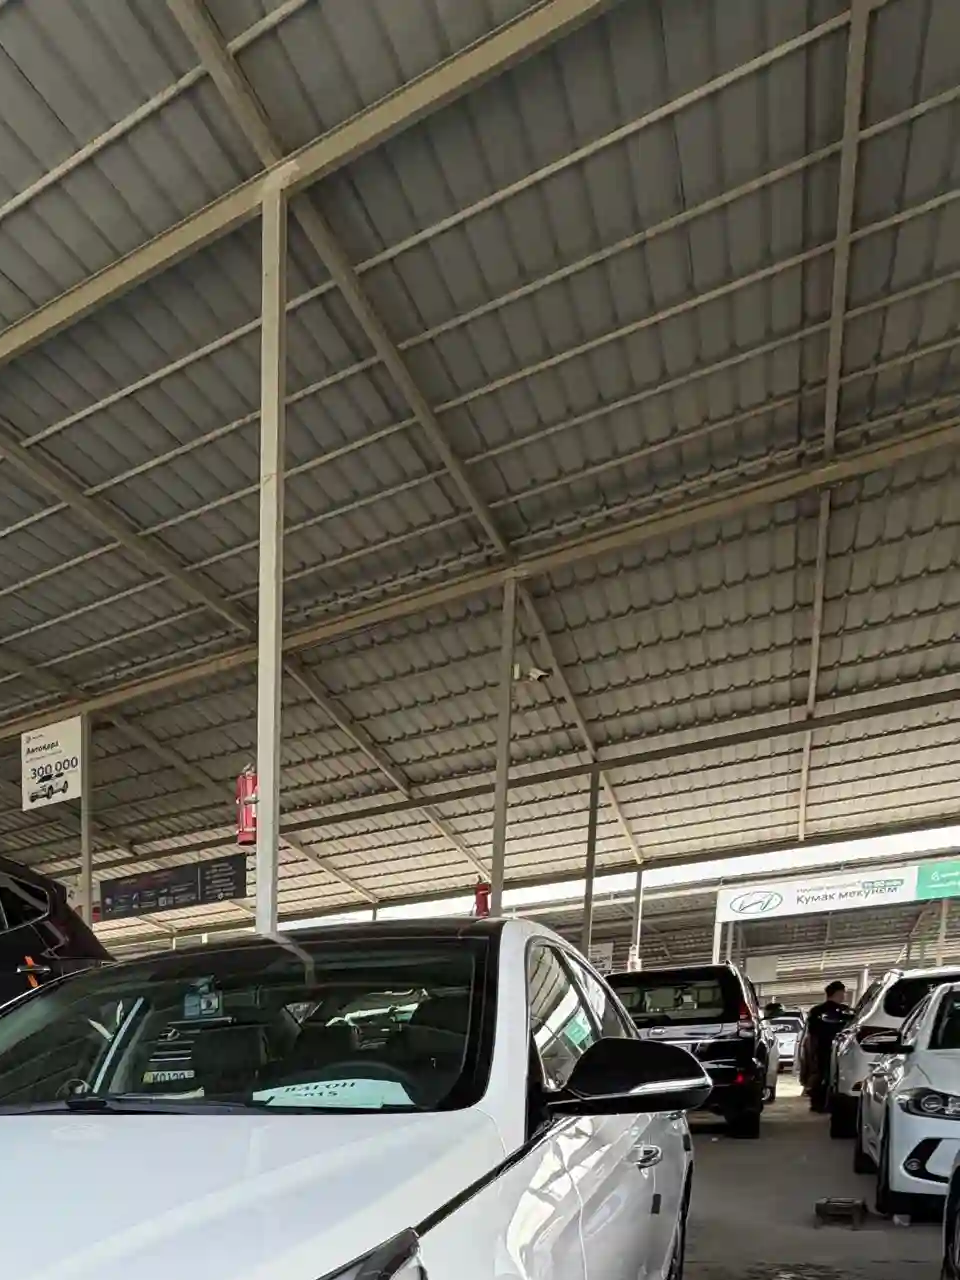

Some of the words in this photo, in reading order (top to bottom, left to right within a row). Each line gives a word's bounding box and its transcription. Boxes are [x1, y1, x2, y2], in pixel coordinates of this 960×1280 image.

[30, 763, 53, 780] 300
[54, 756, 79, 773] 000
[796, 892, 836, 905] Кумак
